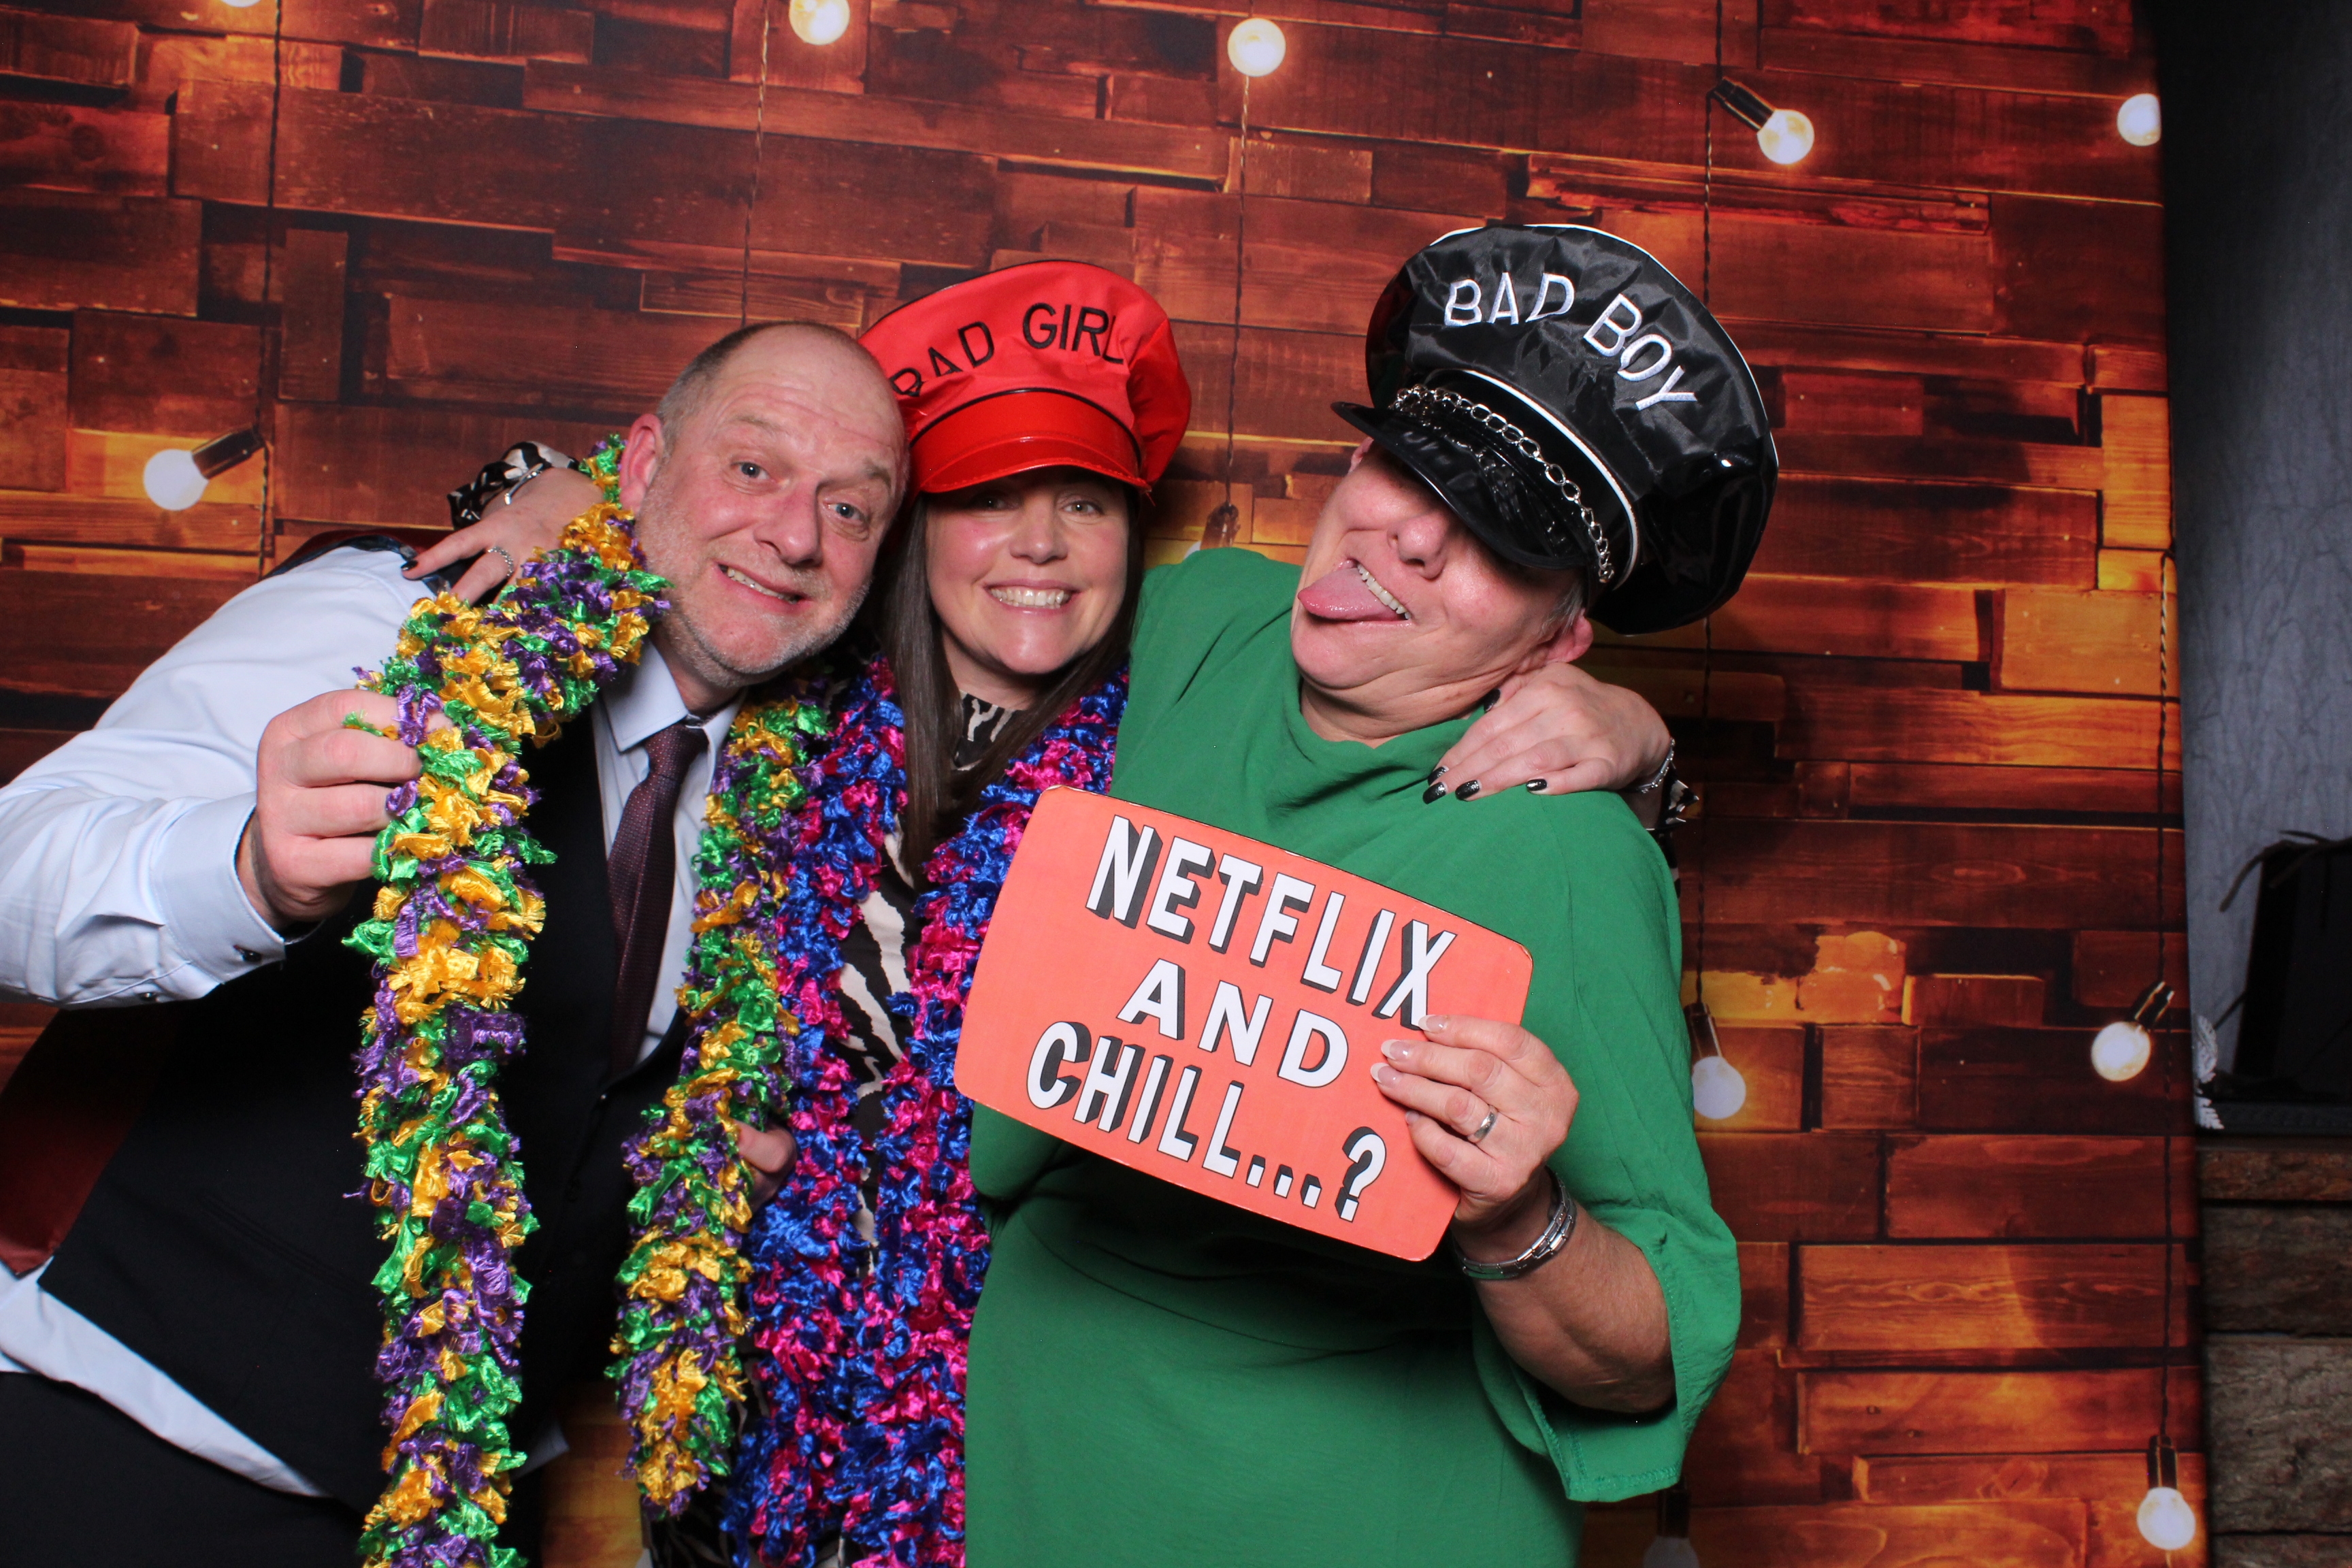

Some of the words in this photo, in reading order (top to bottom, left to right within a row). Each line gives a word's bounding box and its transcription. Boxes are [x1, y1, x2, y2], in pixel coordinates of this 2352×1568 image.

[1023, 303, 1124, 364] GIRL
[1444, 272, 1575, 327] BAD
[1583, 293, 1697, 410] BOY
[1085, 815, 1457, 1030] NETFLIX
[1116, 959, 1349, 1088] AND
